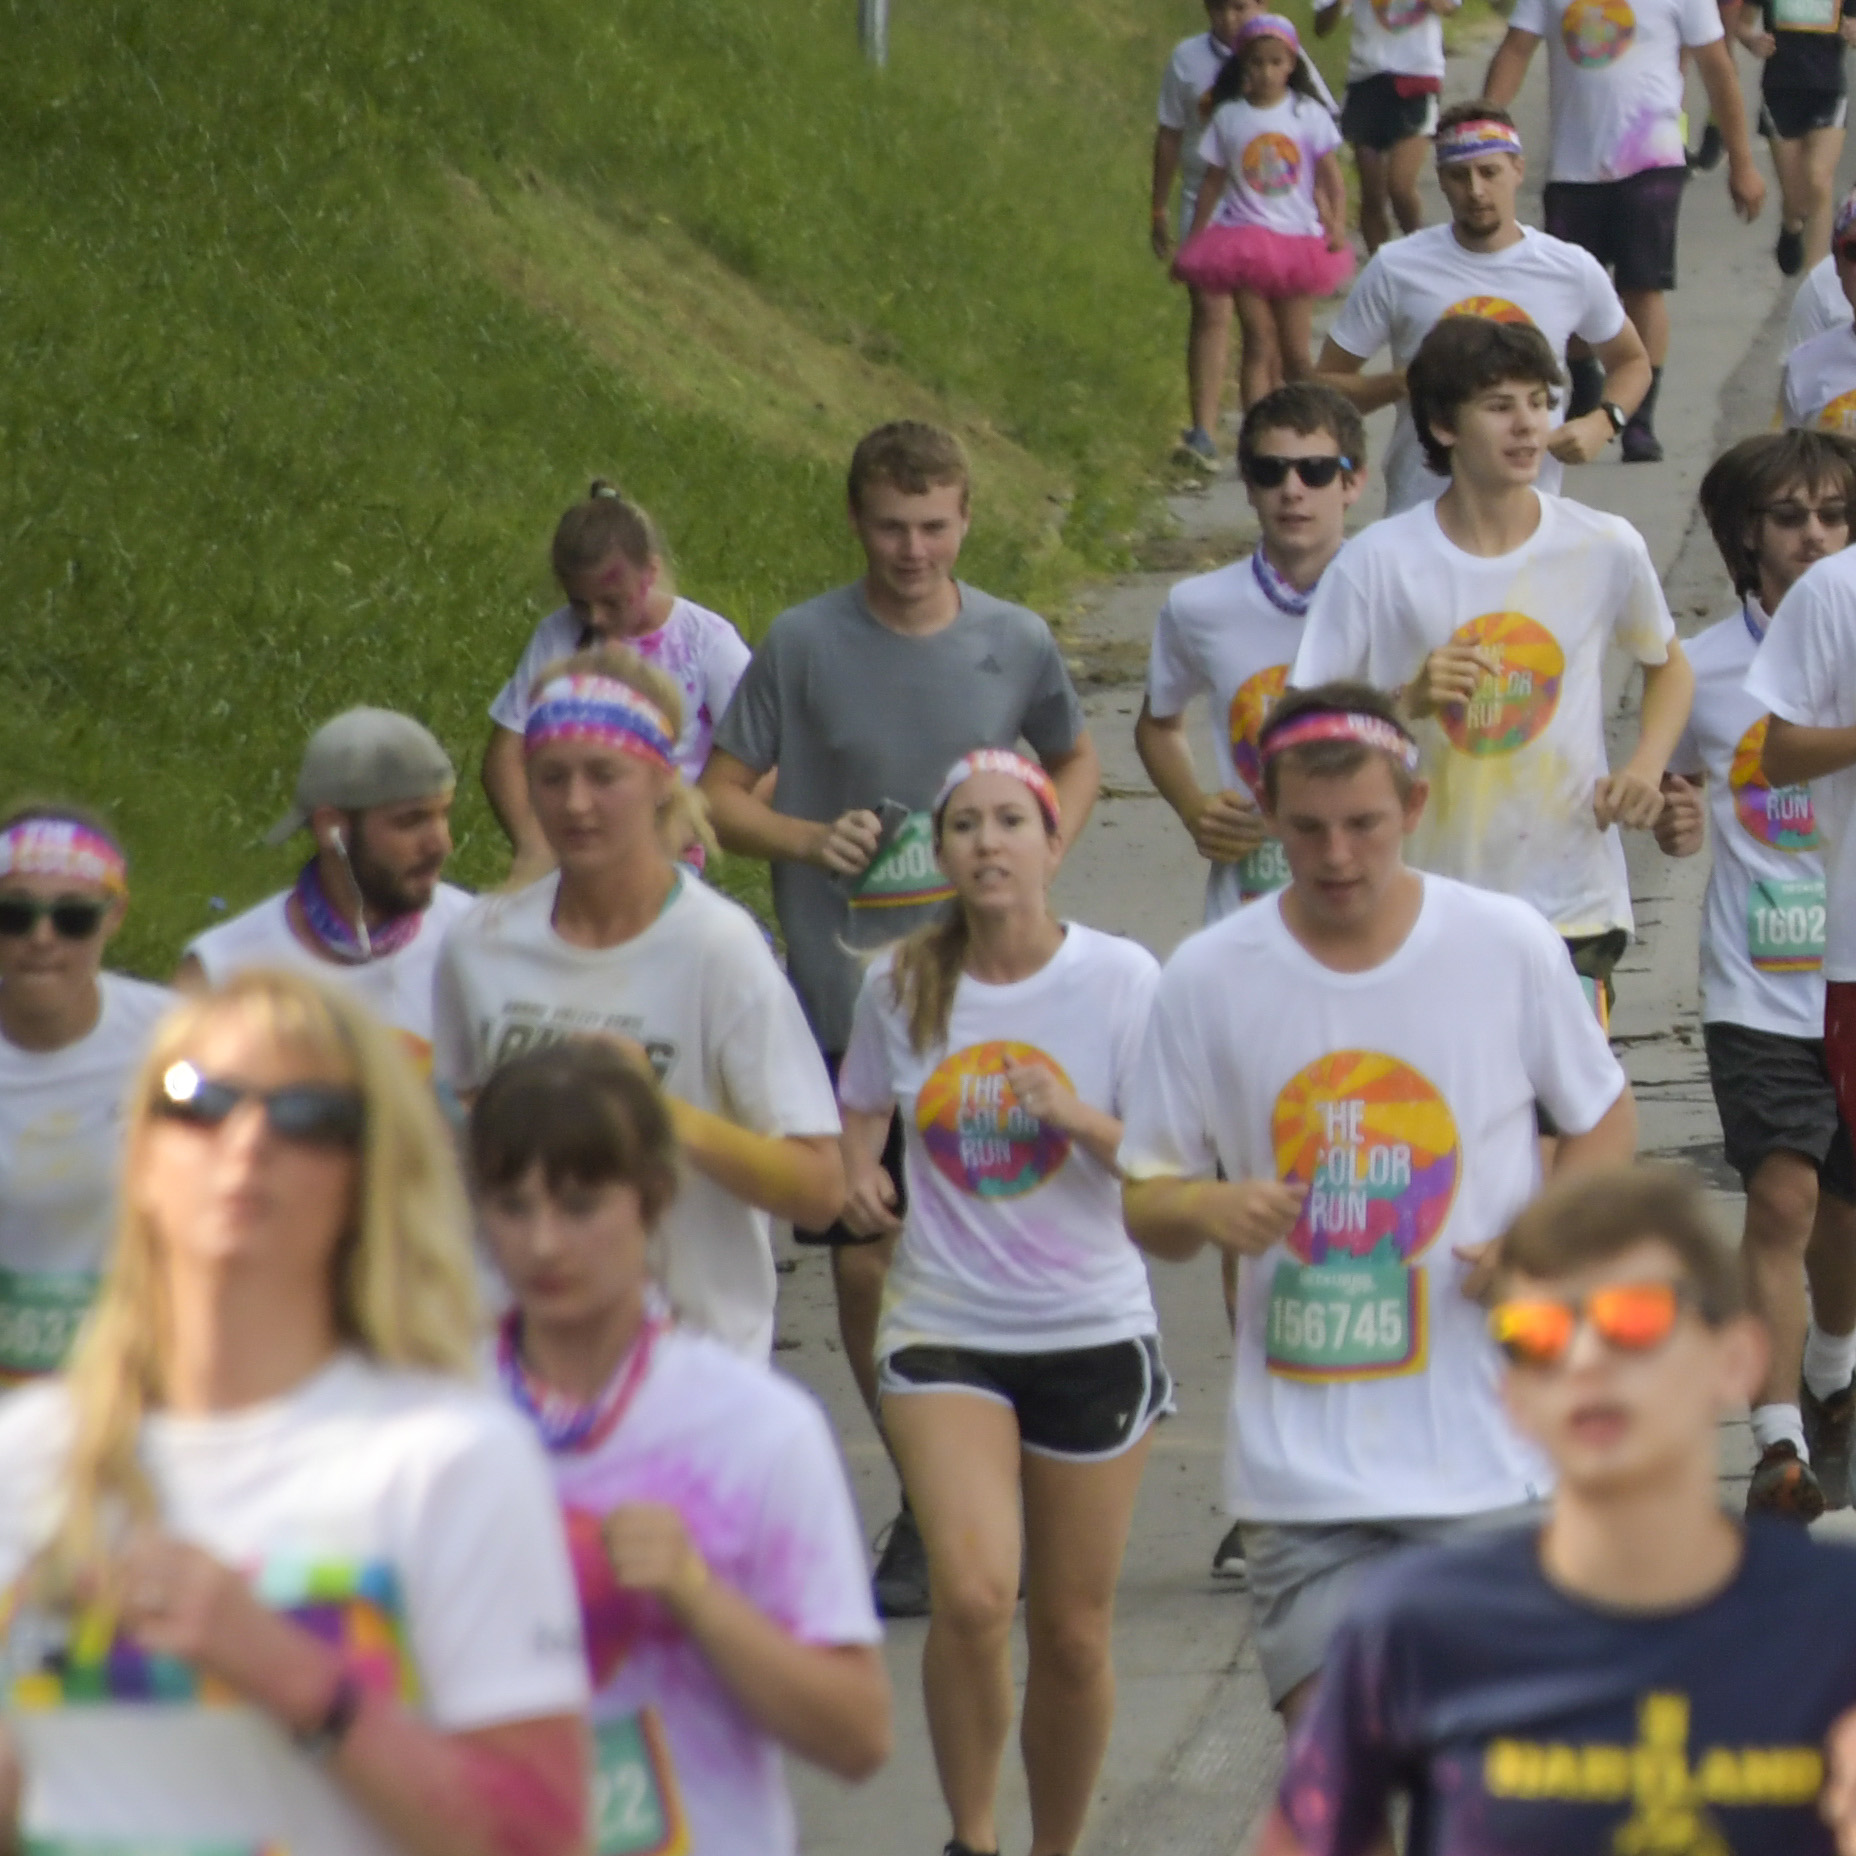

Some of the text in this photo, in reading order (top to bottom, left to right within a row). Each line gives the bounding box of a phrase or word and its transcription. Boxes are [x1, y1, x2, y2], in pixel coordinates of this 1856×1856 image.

[1765, 796, 1809, 822] RUN
[959, 1072, 1008, 1111] THE
[1316, 1099, 1366, 1146] THE
[1310, 1188, 1368, 1235] RUN
[1271, 1298, 1402, 1351] 156745
